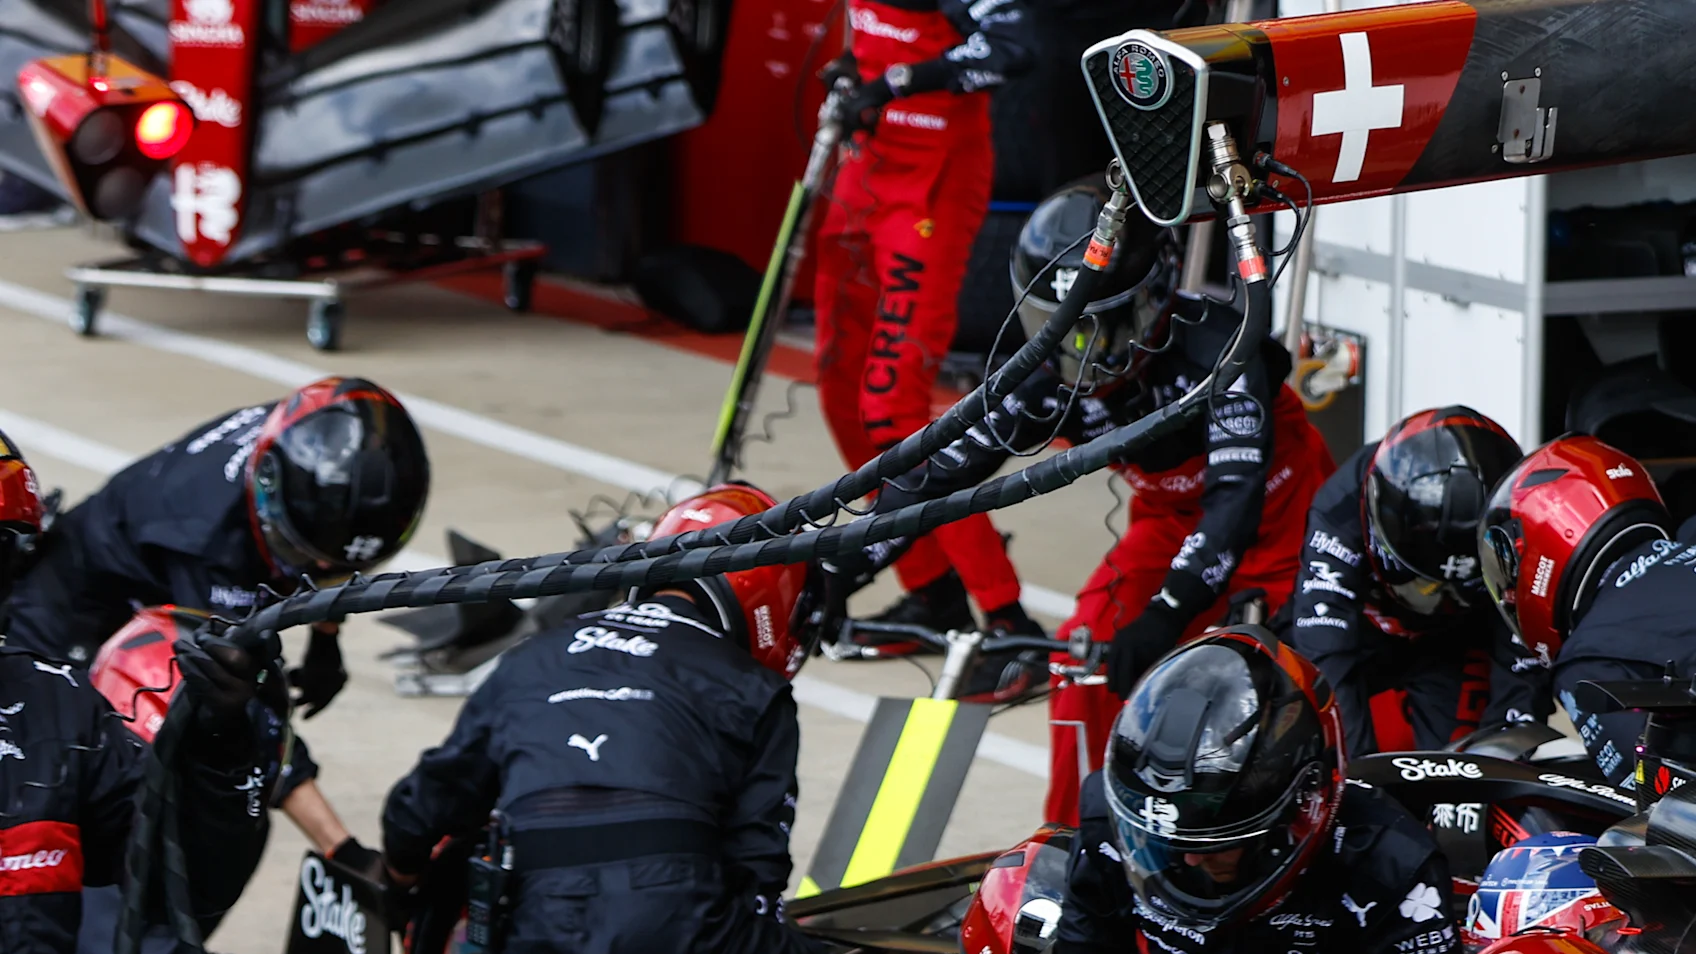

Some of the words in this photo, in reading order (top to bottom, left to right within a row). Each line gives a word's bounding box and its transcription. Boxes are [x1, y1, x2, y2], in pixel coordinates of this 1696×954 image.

[1112, 47, 1128, 75] ALFA
[1131, 44, 1165, 78] ROMEO
[864, 252, 926, 395] CREW
[1606, 463, 1634, 481] Stilo
[1310, 530, 1363, 567] Hyland
[1531, 555, 1549, 596] MASCOT
[567, 626, 660, 657] Stake
[760, 605, 776, 649] MASCOT
[1391, 756, 1484, 781] Stake
[1394, 930, 1444, 951] WEB
